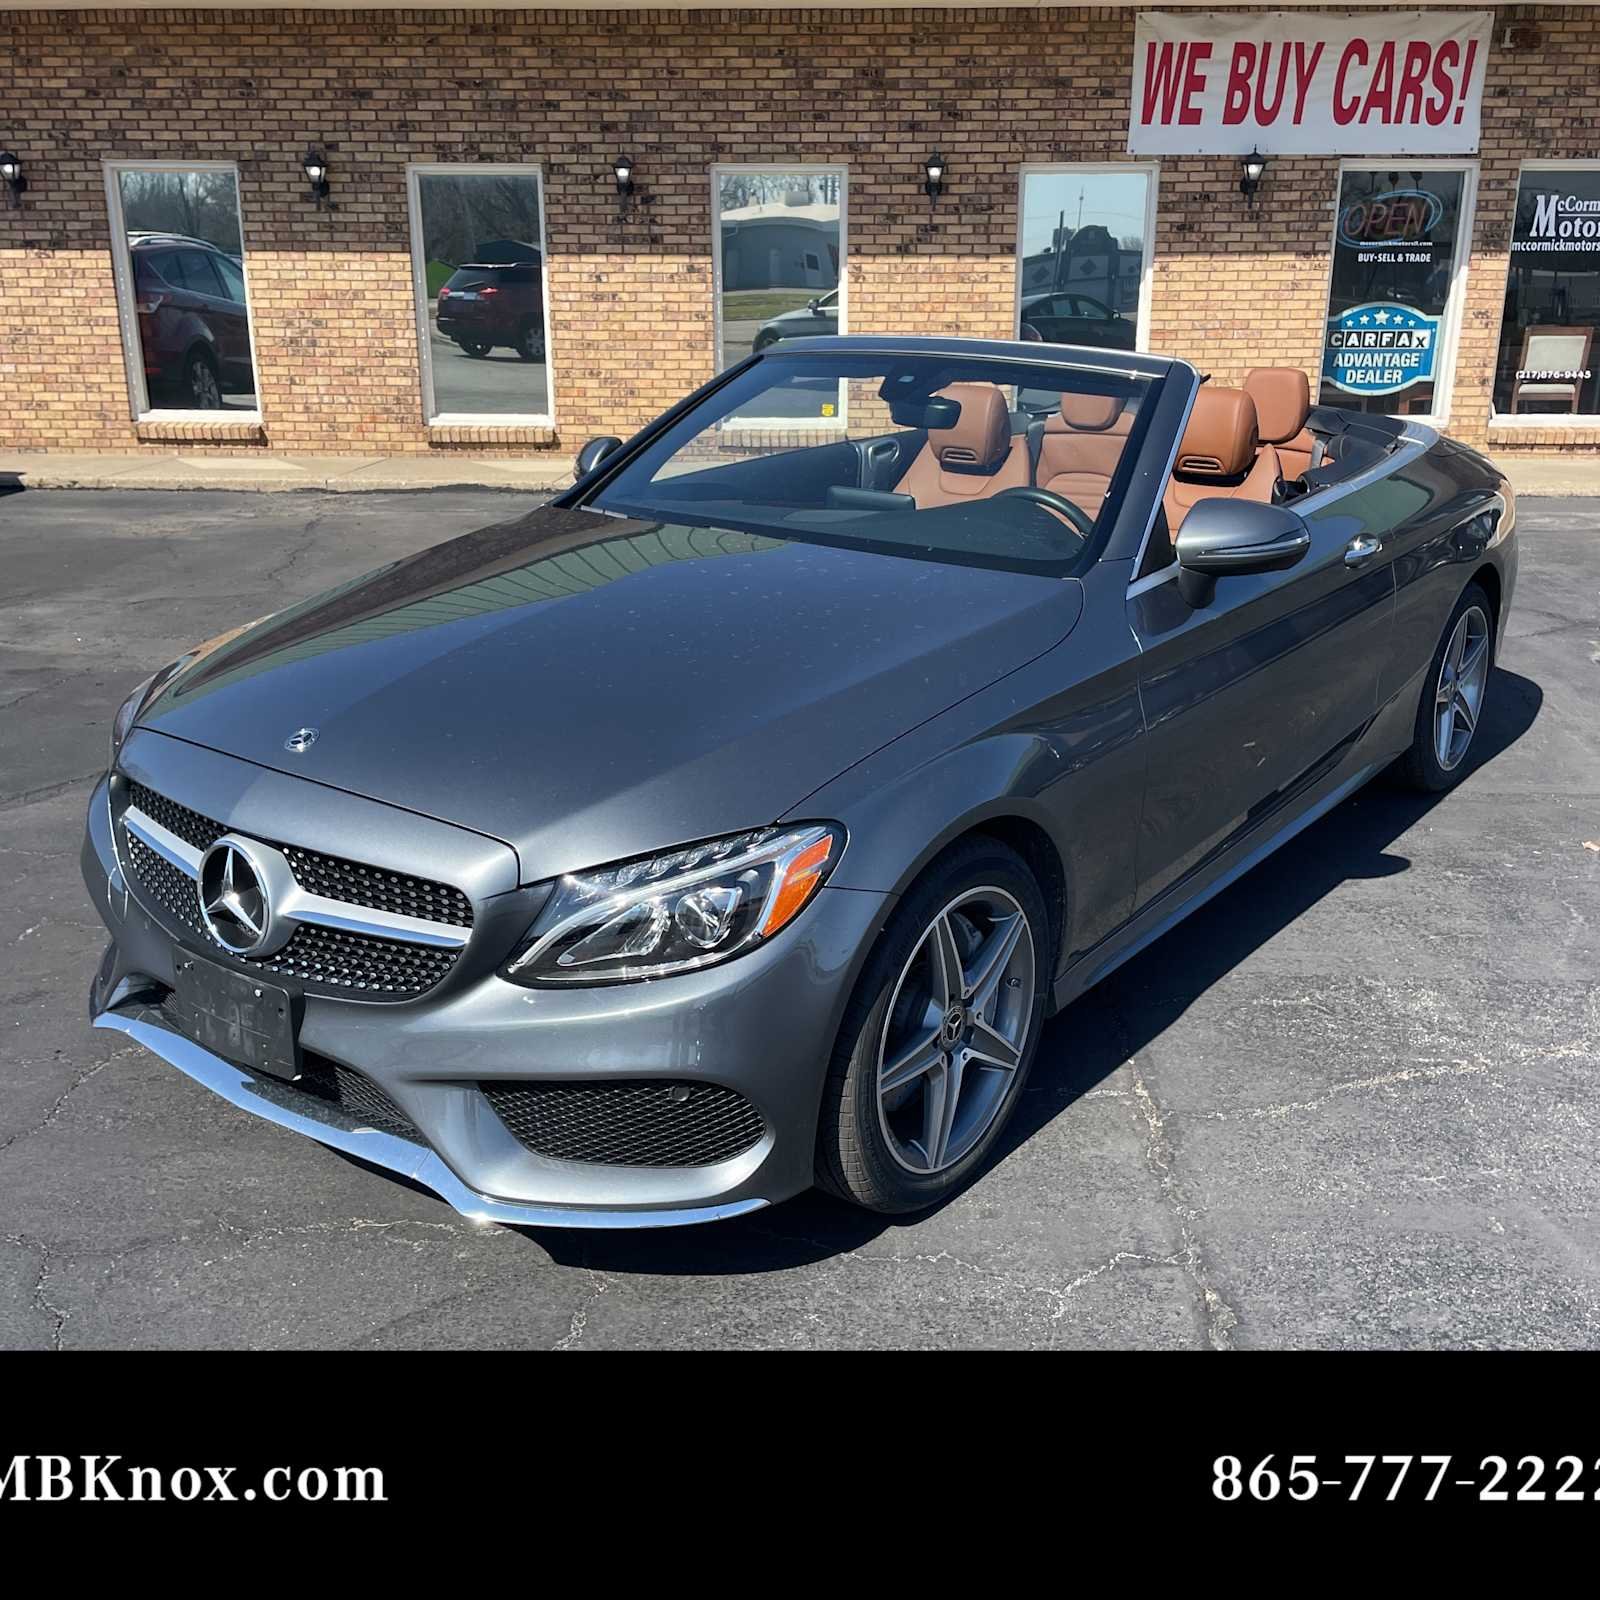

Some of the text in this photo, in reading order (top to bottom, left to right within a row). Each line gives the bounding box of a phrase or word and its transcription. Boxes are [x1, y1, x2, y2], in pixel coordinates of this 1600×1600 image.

[1141, 38, 1478, 126] WE BUY CARS!
[1344, 202, 1428, 237] OPEN
[1405, 253, 1431, 263] TRADE
[1330, 332, 1427, 348] CARFAX
[1332, 353, 1420, 367] ADVANTAGE
[1345, 369, 1403, 384] DEALER
